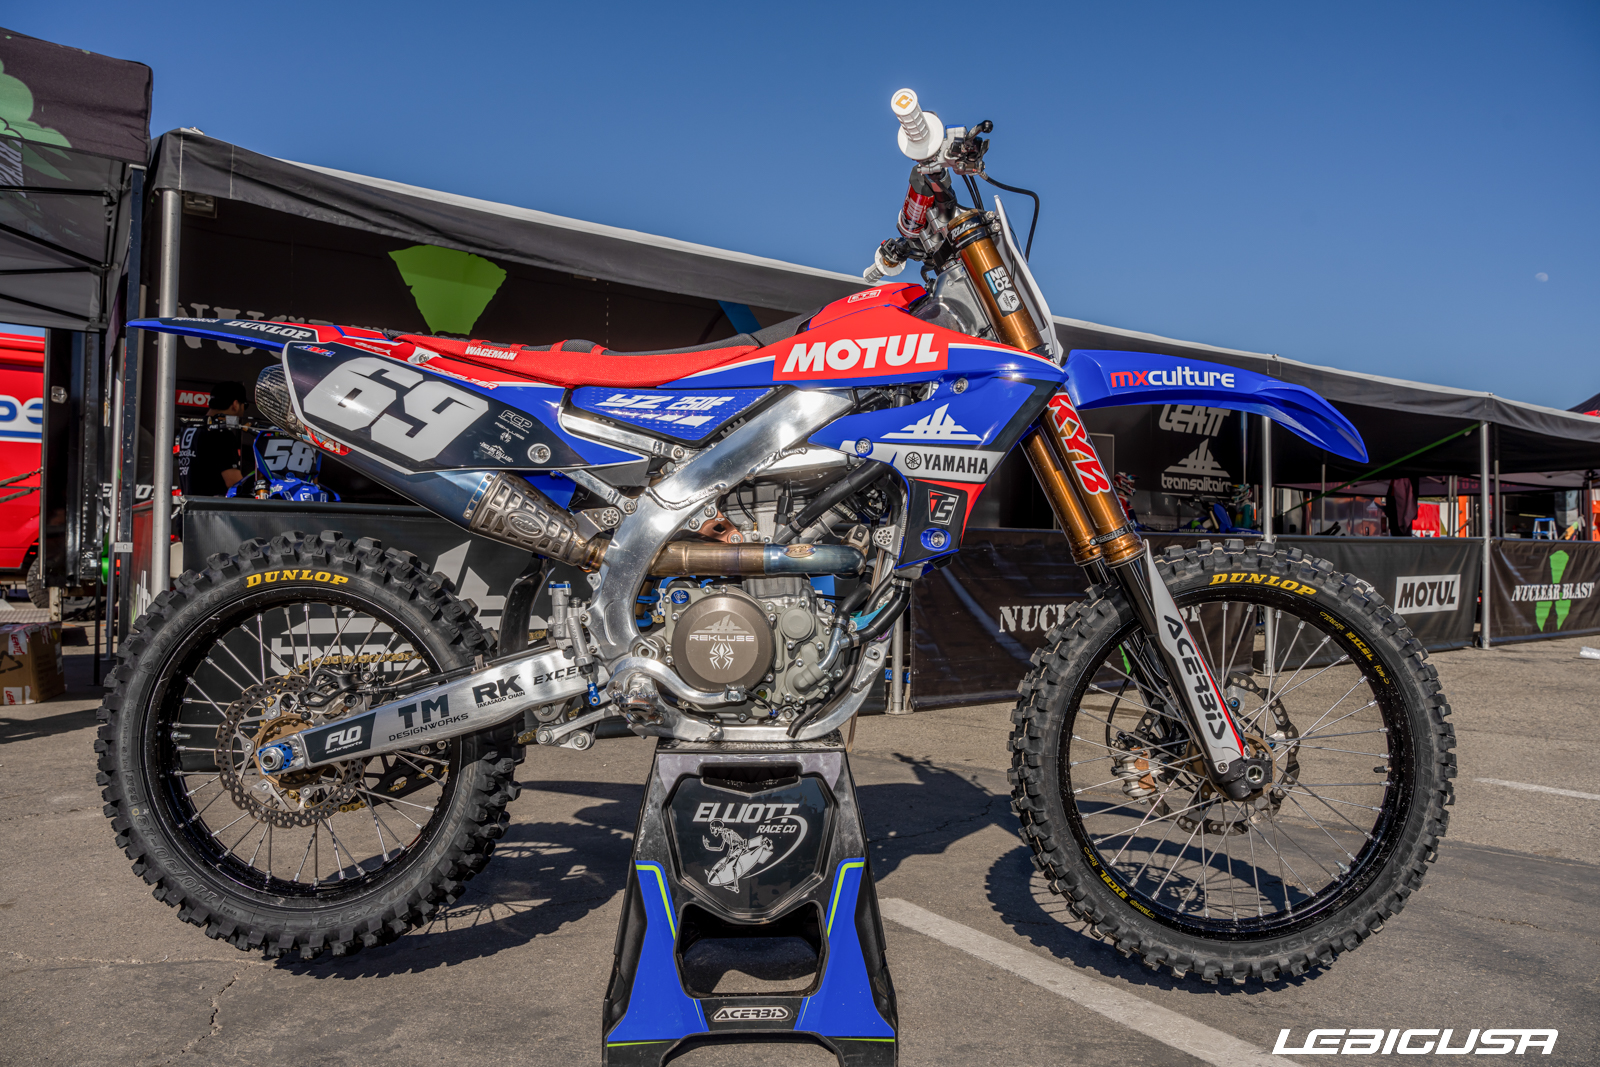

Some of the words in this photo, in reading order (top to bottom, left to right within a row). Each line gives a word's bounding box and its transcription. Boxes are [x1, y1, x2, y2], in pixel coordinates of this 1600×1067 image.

[224, 320, 312, 340] DUNLOP
[782, 333, 940, 373] MOTUL
[1110, 366, 1235, 388] mxculture
[303, 357, 489, 462] 69
[595, 393, 675, 409] YZ
[500, 409, 533, 428] FCP
[1047, 391, 1111, 495] KYB
[264, 438, 316, 473] 58
[924, 453, 988, 475] YAMAHA
[246, 569, 348, 588] DUNLOP
[1209, 572, 1317, 595] DUNLOP
[1398, 580, 1456, 609] MOTUL
[1511, 584, 1561, 602] NUCLEAR
[1561, 582, 1595, 600] BLAST
[690, 634, 754, 642] REKLUSE
[1345, 631, 1374, 661] EXCEL
[533, 665, 582, 685] EXCE
[1164, 615, 1227, 740] ACERBIS
[472, 674, 524, 704] RK
[477, 696, 507, 708] TAKASAGO
[508, 691, 525, 700] CHAIN
[398, 694, 449, 729] TM
[325, 726, 362, 750] FLO
[389, 713, 469, 741] DESIGNWORKS
[693, 802, 799, 824] ELLIOTT
[756, 824, 782, 834] RACE
[783, 824, 798, 834] CO
[1100, 869, 1128, 900] EXCEL
[715, 1008, 789, 1020] ACERBIS
